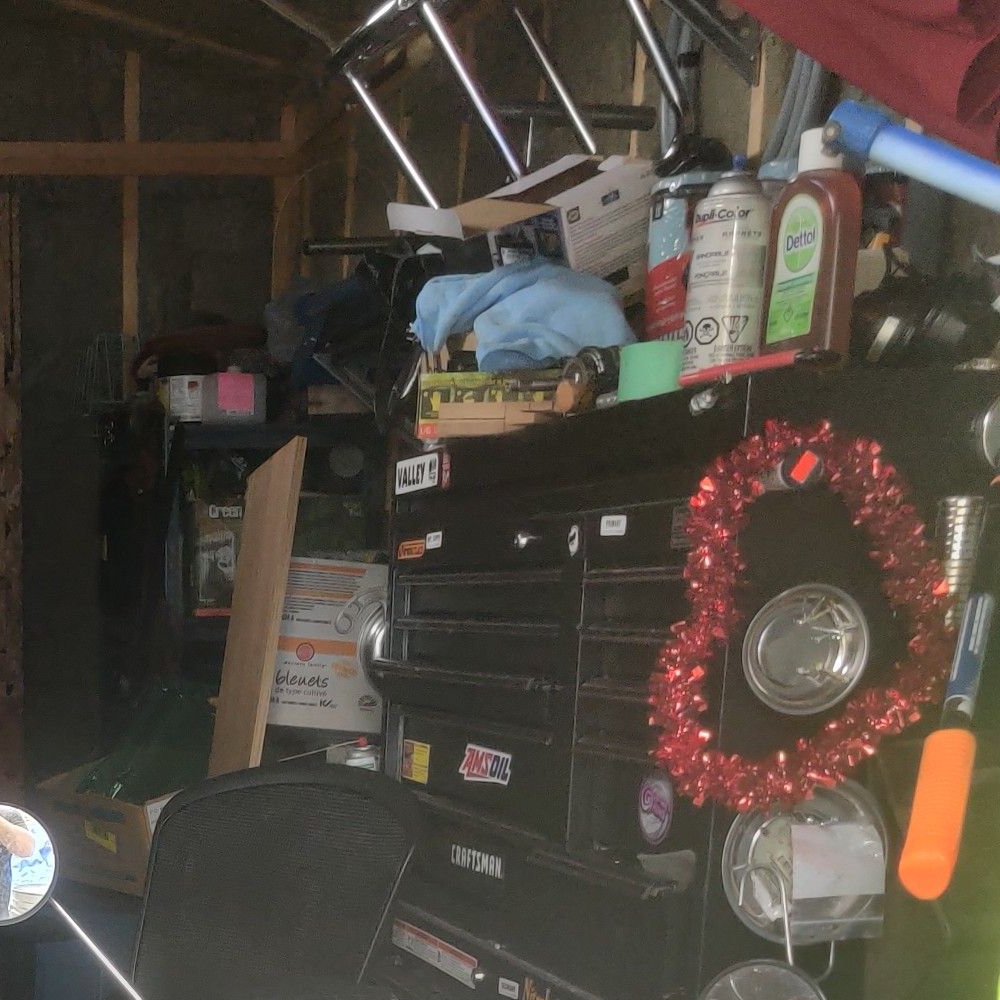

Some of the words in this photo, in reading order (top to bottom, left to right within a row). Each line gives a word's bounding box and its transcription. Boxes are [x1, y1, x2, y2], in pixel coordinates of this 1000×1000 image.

[786, 226, 816, 251] Dettol
[398, 461, 426, 489] VALLEY
[209, 504, 242, 519] Green
[276, 669, 329, 688] bleuets
[462, 747, 510, 781] AMSOIL
[451, 844, 503, 879] CRAFTSMAN
